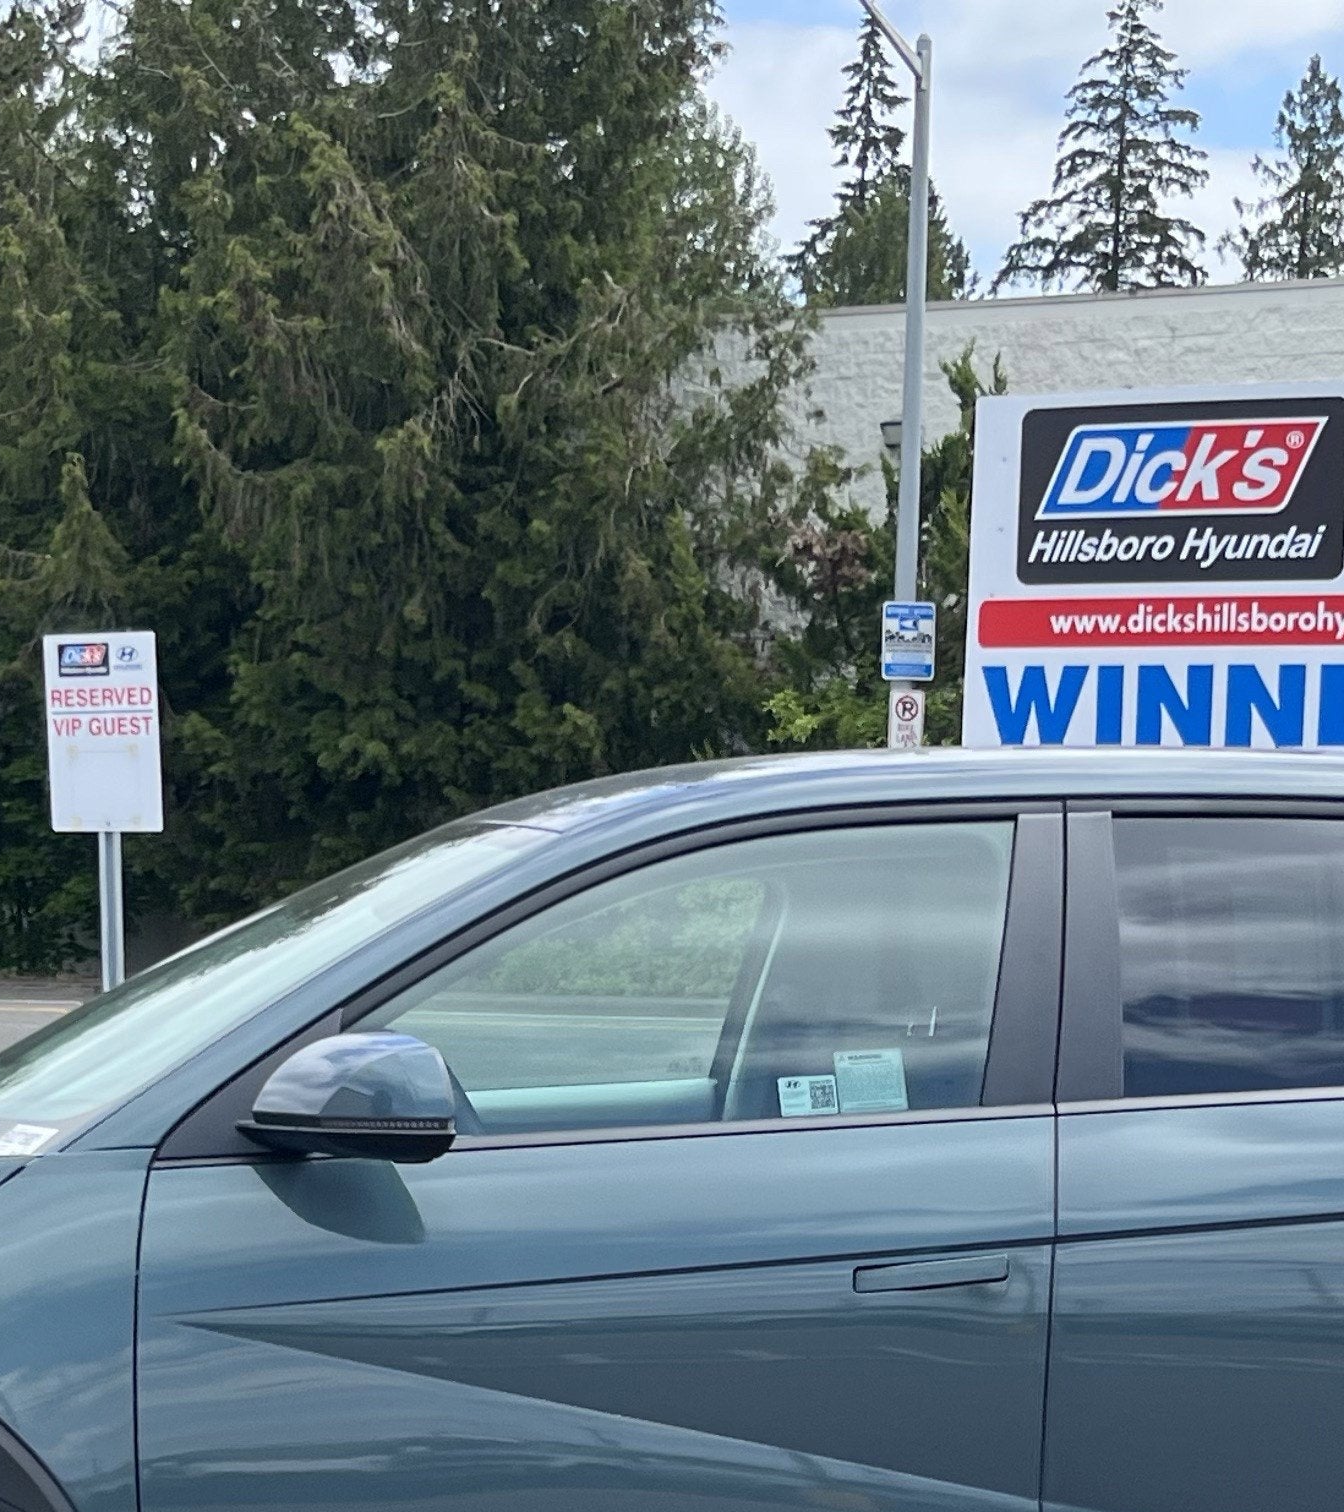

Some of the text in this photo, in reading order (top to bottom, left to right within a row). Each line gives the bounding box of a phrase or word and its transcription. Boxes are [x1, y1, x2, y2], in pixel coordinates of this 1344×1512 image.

[1027, 524, 1328, 569] Hillsboro Hyundai
[50, 687, 152, 708] RESERVED
[52, 716, 153, 737] VIP GUEST
